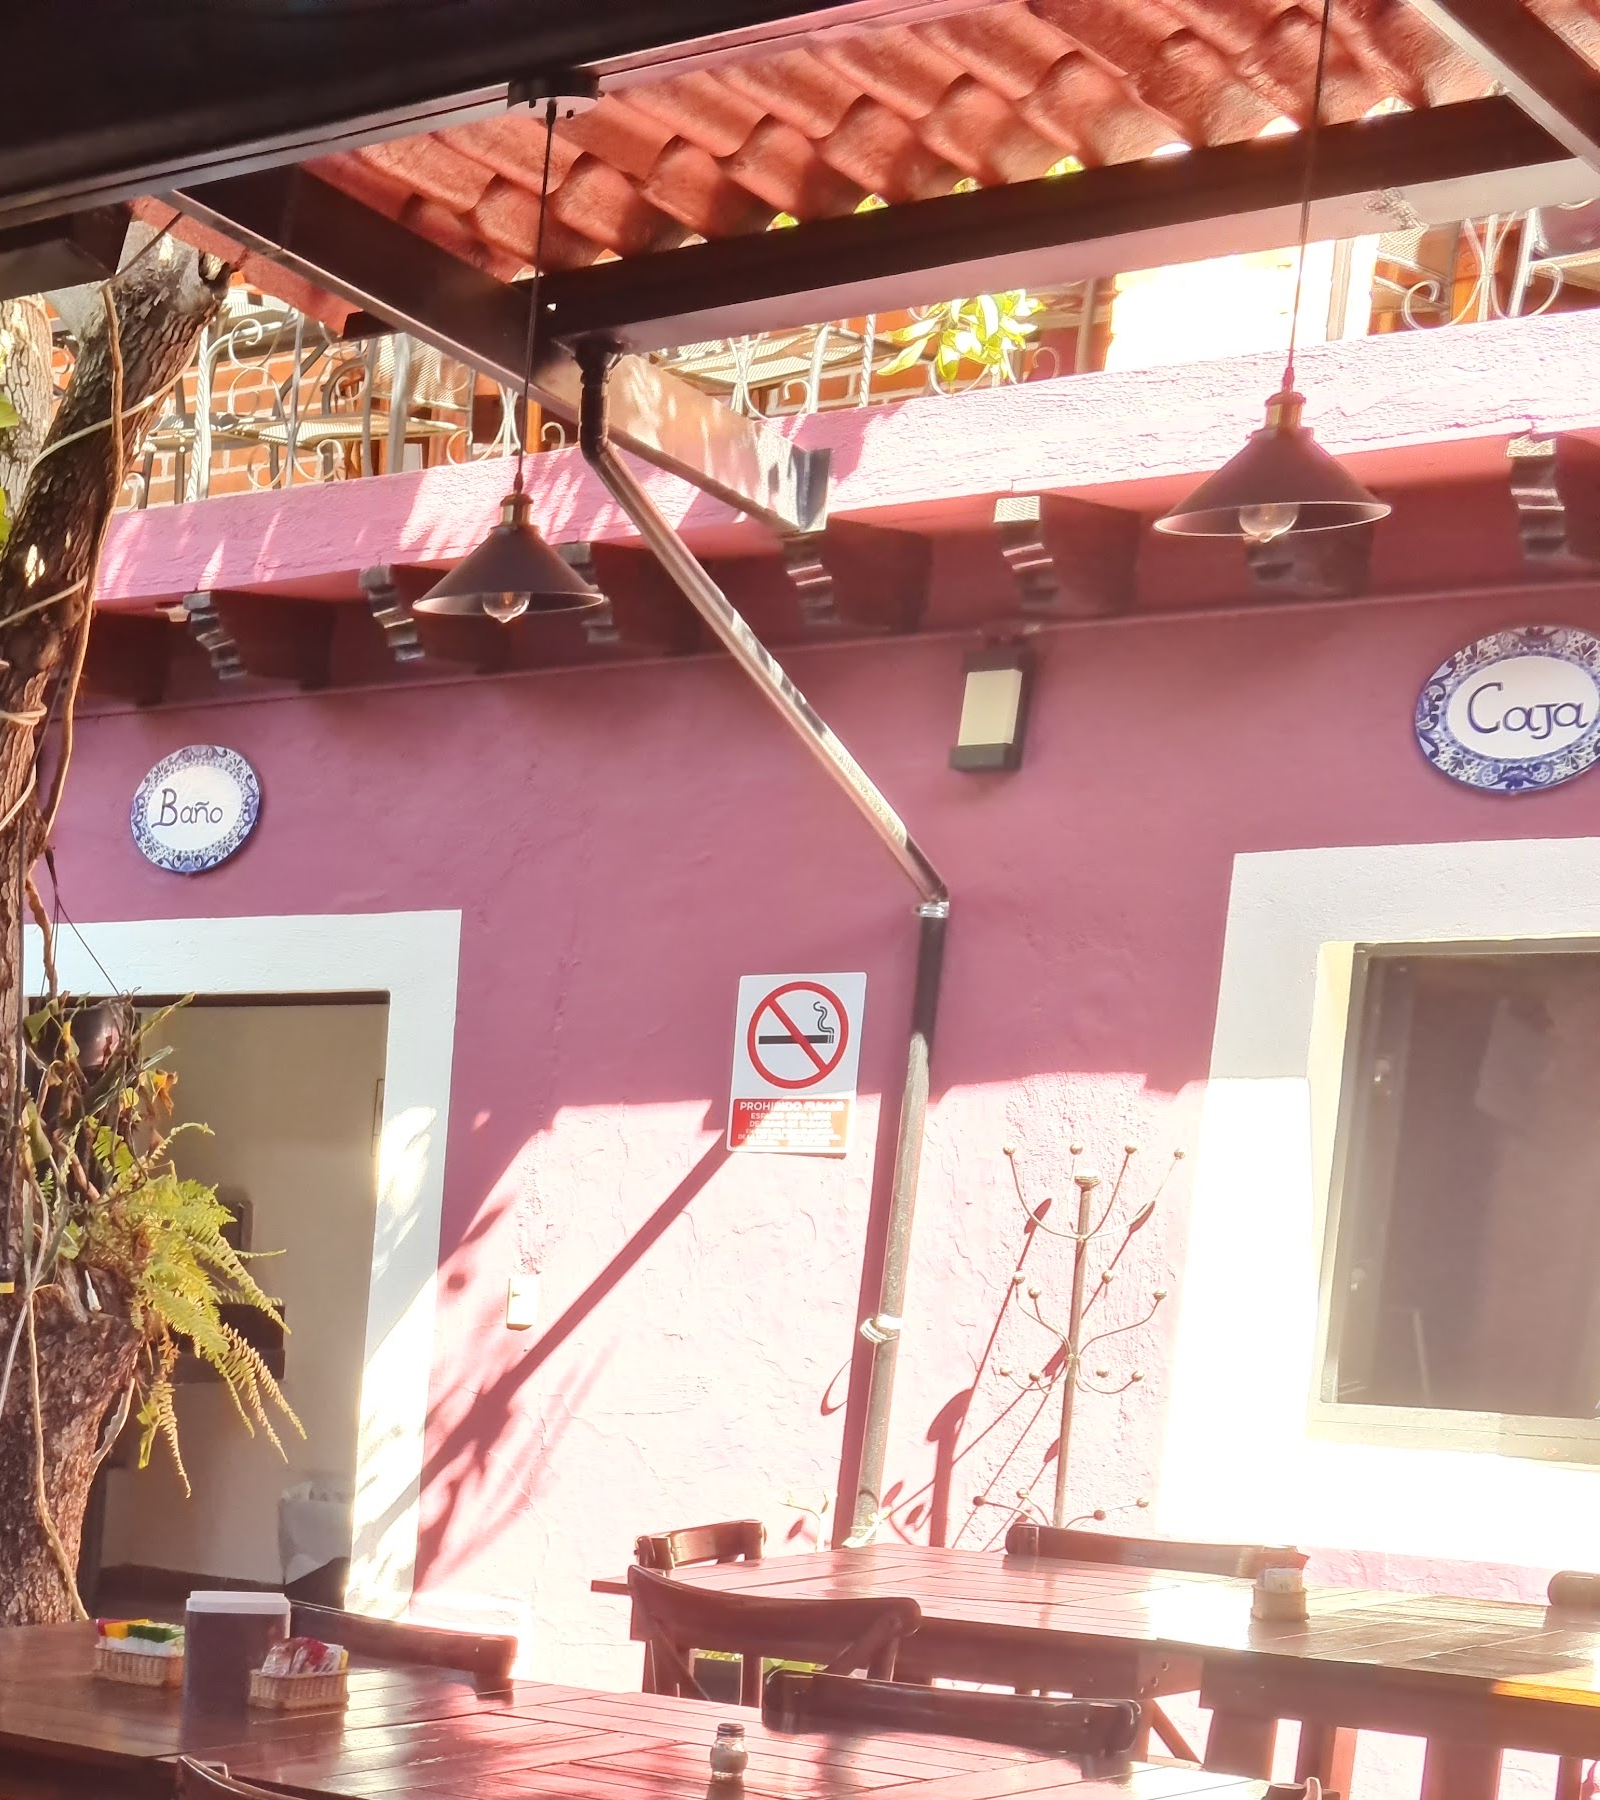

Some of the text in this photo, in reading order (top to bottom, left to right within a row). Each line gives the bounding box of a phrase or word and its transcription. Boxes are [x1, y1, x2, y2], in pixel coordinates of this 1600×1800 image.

[1467, 681, 1590, 741] Caja
[151, 787, 224, 829] Baño
[740, 1101, 802, 1111] PROHIDO
